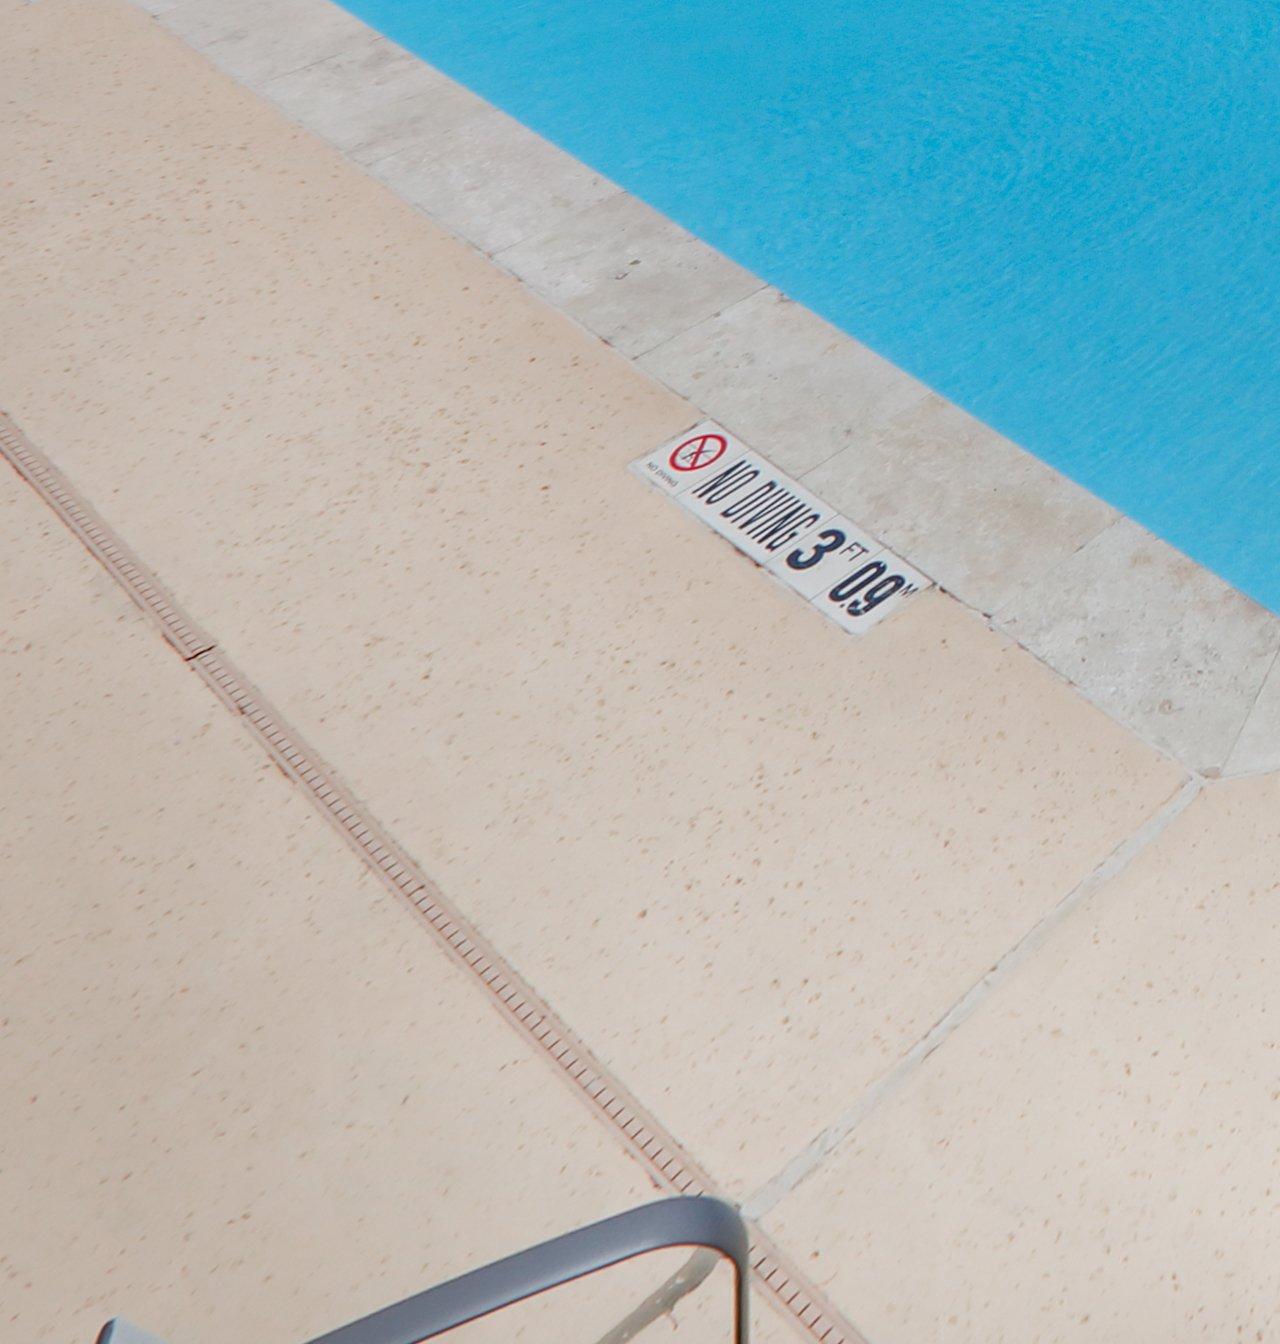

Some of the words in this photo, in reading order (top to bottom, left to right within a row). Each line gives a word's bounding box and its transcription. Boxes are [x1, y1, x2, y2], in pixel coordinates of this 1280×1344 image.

[692, 459, 760, 505] NO
[720, 480, 821, 552] DIVING
[786, 528, 847, 570] 3
[839, 541, 870, 562] FT
